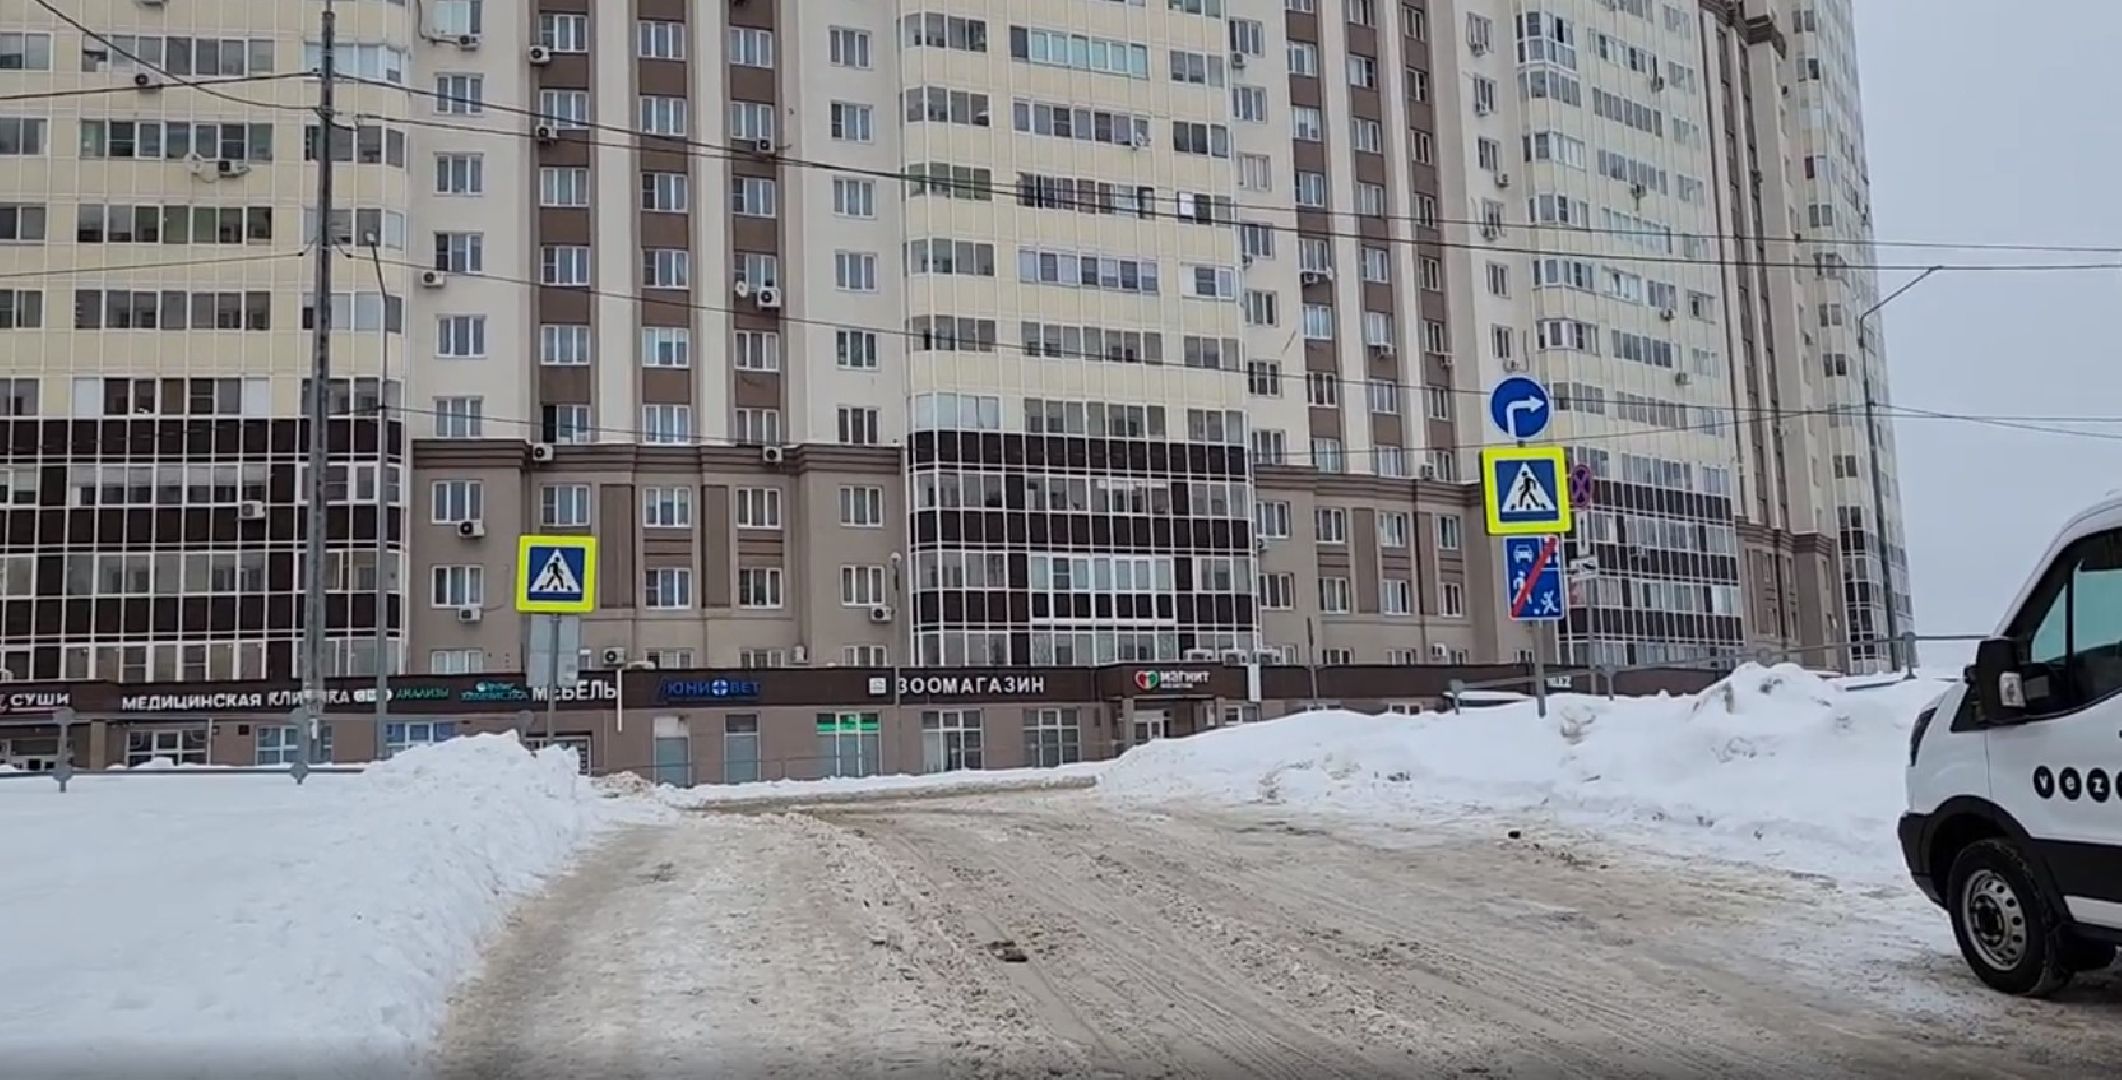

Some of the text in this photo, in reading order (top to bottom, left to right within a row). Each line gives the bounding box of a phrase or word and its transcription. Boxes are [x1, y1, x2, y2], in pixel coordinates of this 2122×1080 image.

[899, 677, 1045, 694] ЗООМАГАЗИН
[9, 692, 70, 707] СУШИ
[122, 691, 262, 711] МЕДИЦИНСКАЯ
[268, 688, 350, 706] КЛИКА
